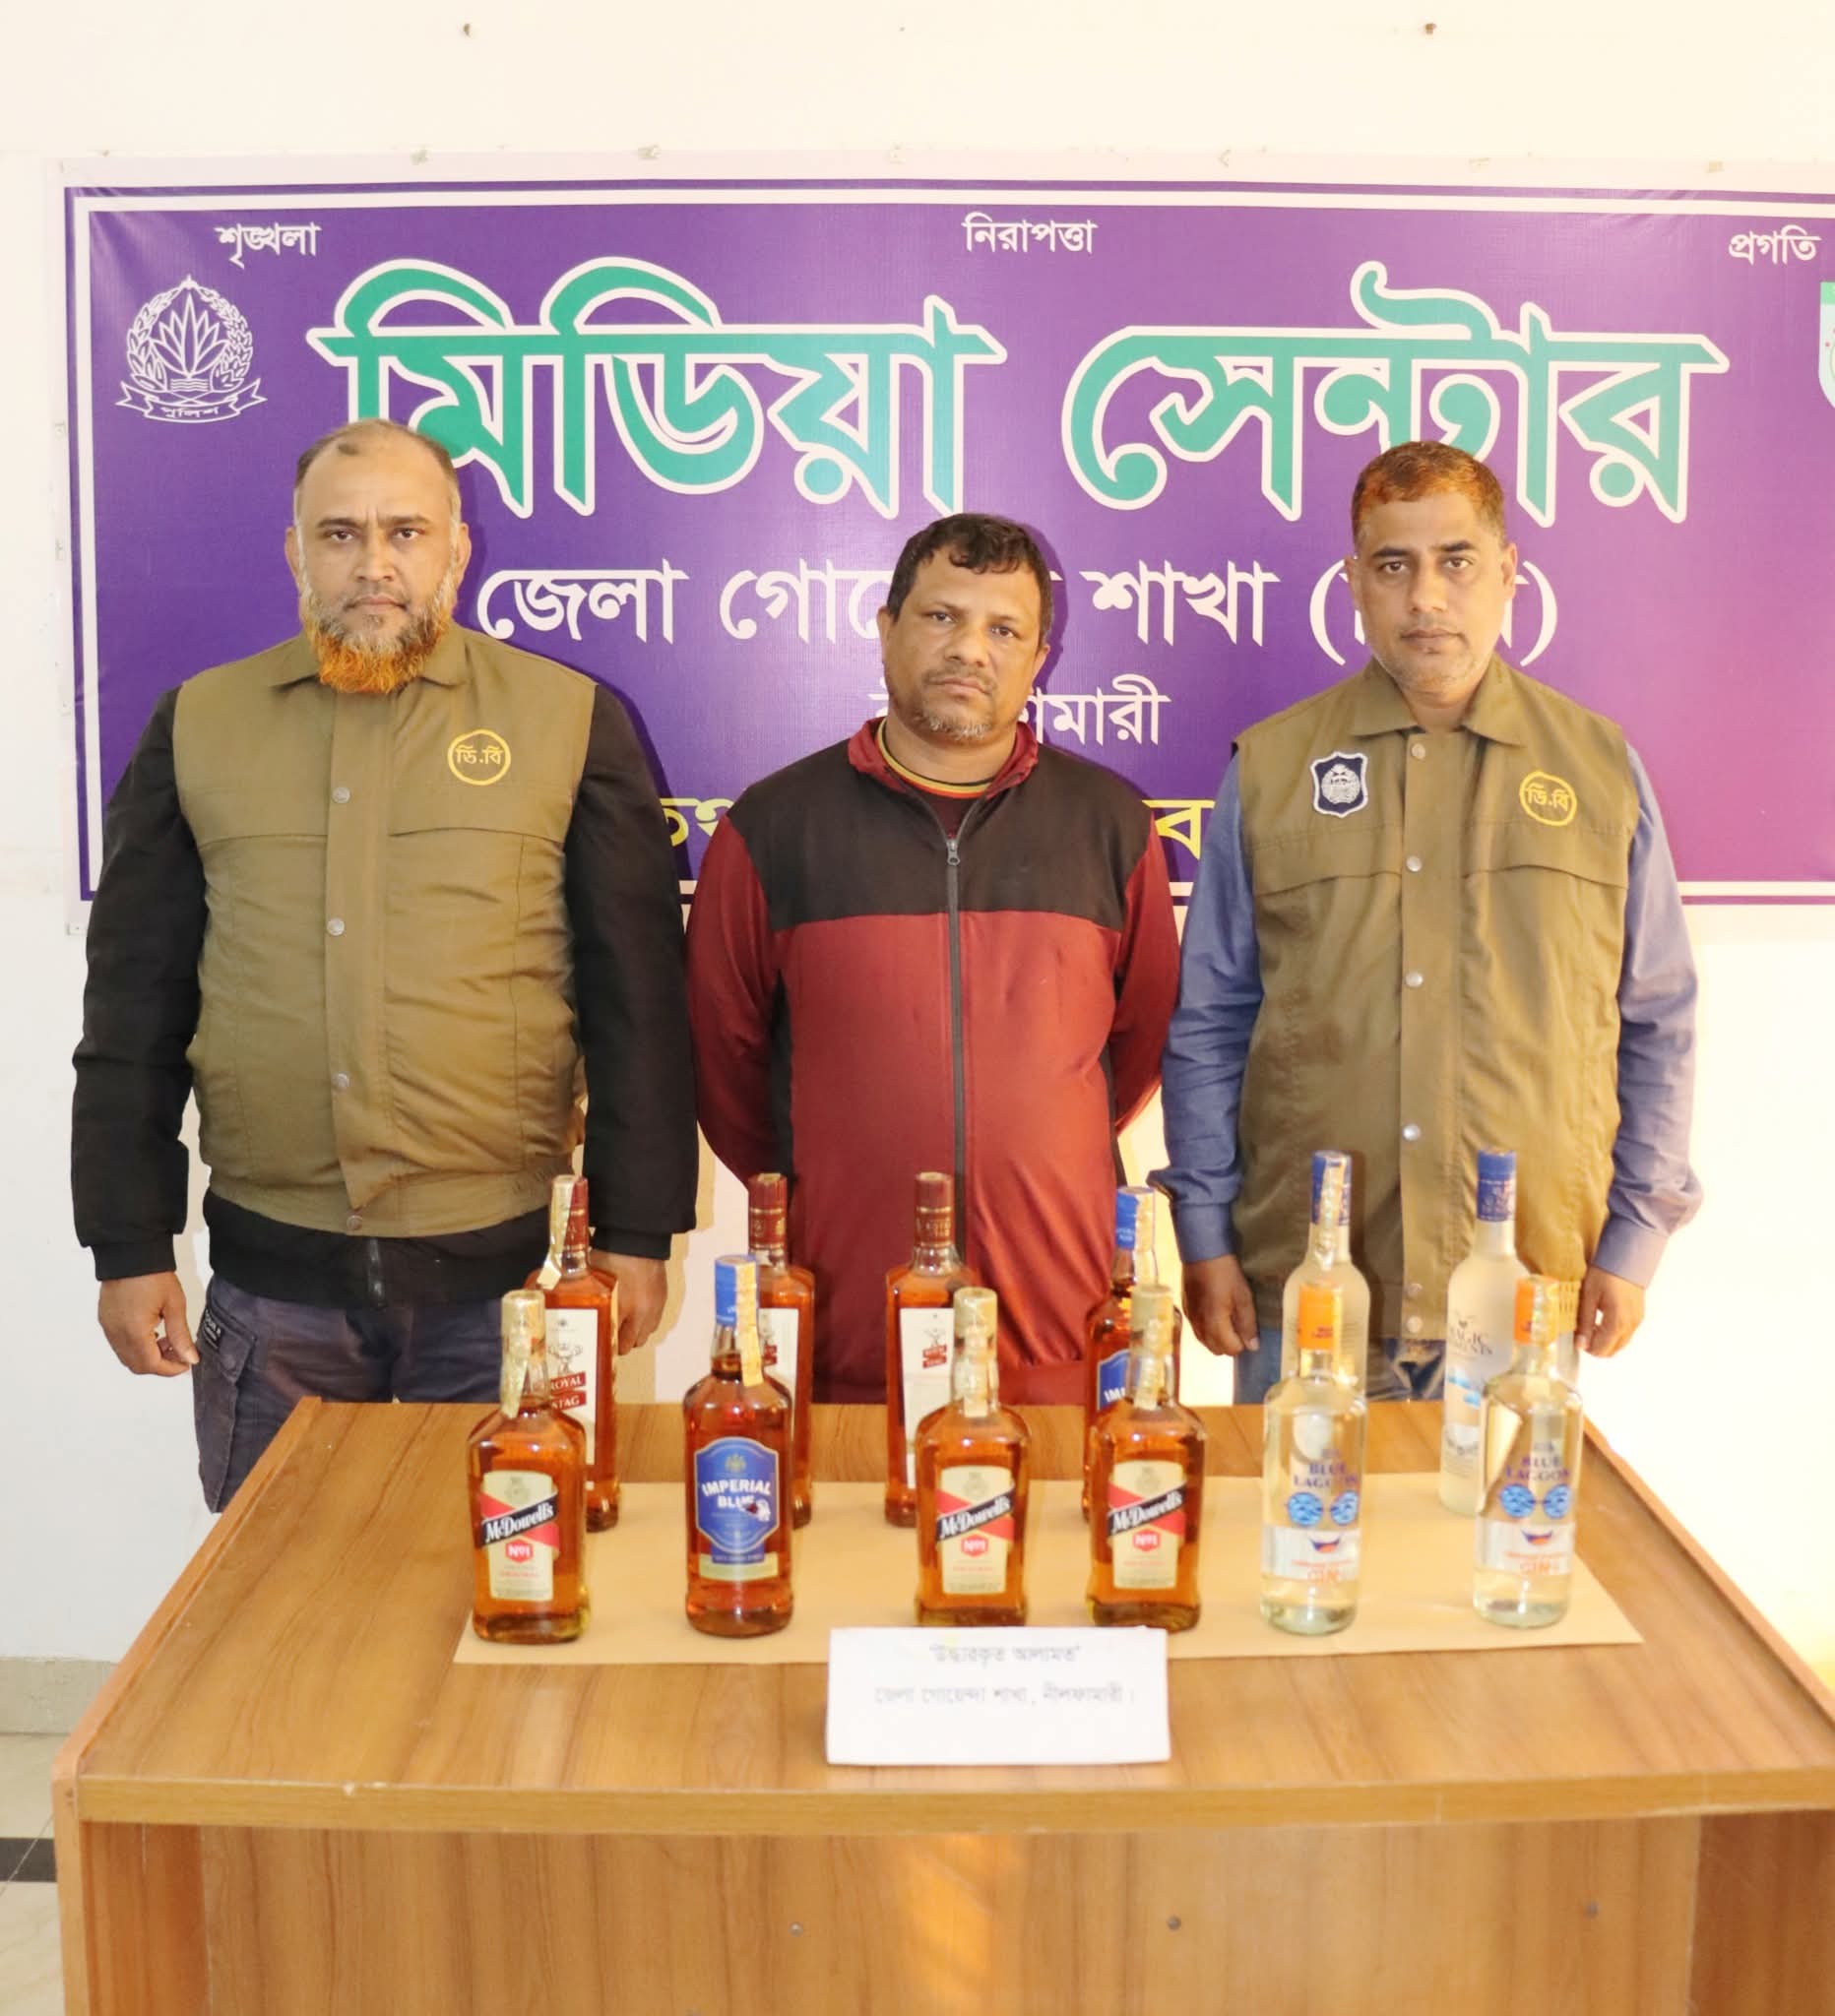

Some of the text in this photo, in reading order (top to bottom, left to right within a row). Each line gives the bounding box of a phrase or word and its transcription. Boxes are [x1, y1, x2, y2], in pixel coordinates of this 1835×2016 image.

[214, 221, 322, 270] শৃঙ্খলা
[962, 212, 1098, 253] নিরাপত্তা
[1728, 224, 1822, 265] প্রগতি
[306, 257, 1730, 528] মিডিয়া সেন্টার
[476, 558, 689, 645] জেলা
[1080, 558, 1280, 647] শাখা
[702, 1479, 771, 1496] IMPERIAL
[485, 1501, 554, 1544] McDowell's
